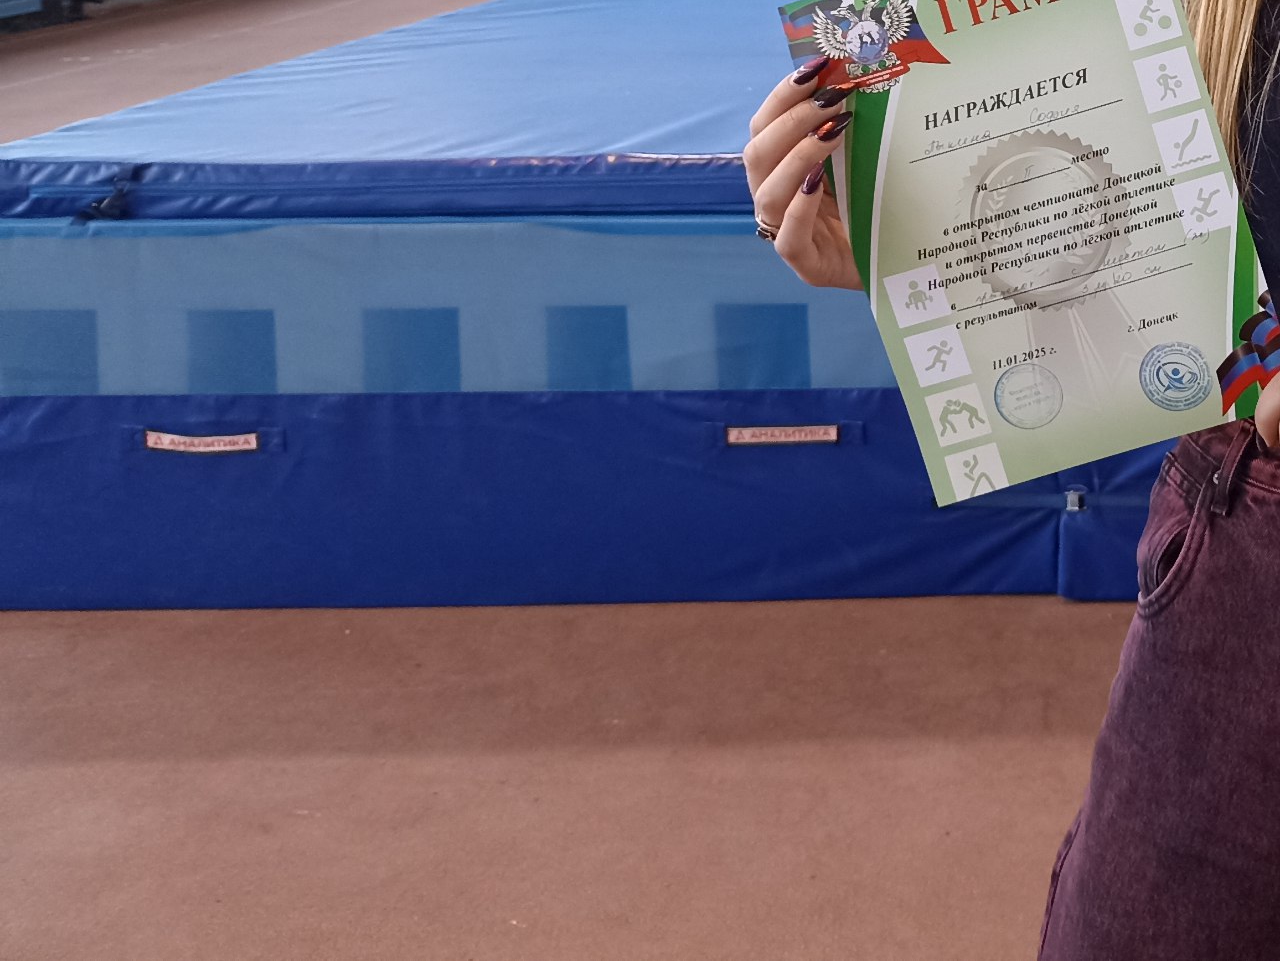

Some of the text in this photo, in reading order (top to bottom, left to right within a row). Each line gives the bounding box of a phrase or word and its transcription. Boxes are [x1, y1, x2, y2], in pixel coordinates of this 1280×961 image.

[924, 67, 1088, 131] НАГРАЖДАЕТСЯ
[1070, 146, 1109, 165] место
[943, 164, 1162, 236] в открытом чемпионате Донецкой
[975, 183, 988, 193] за
[917, 177, 1176, 261] Народной Республики по лёгкой атлетике
[945, 199, 1158, 270] и открытом первенстве Донецкой
[928, 209, 1185, 291] Народной Республики по лёгкой атлетике
[950, 302, 957, 311] в
[955, 300, 1038, 331] с результатом
[1127, 312, 1179, 333] г. Донецк
[992, 347, 1046, 370] 11.01.2025
